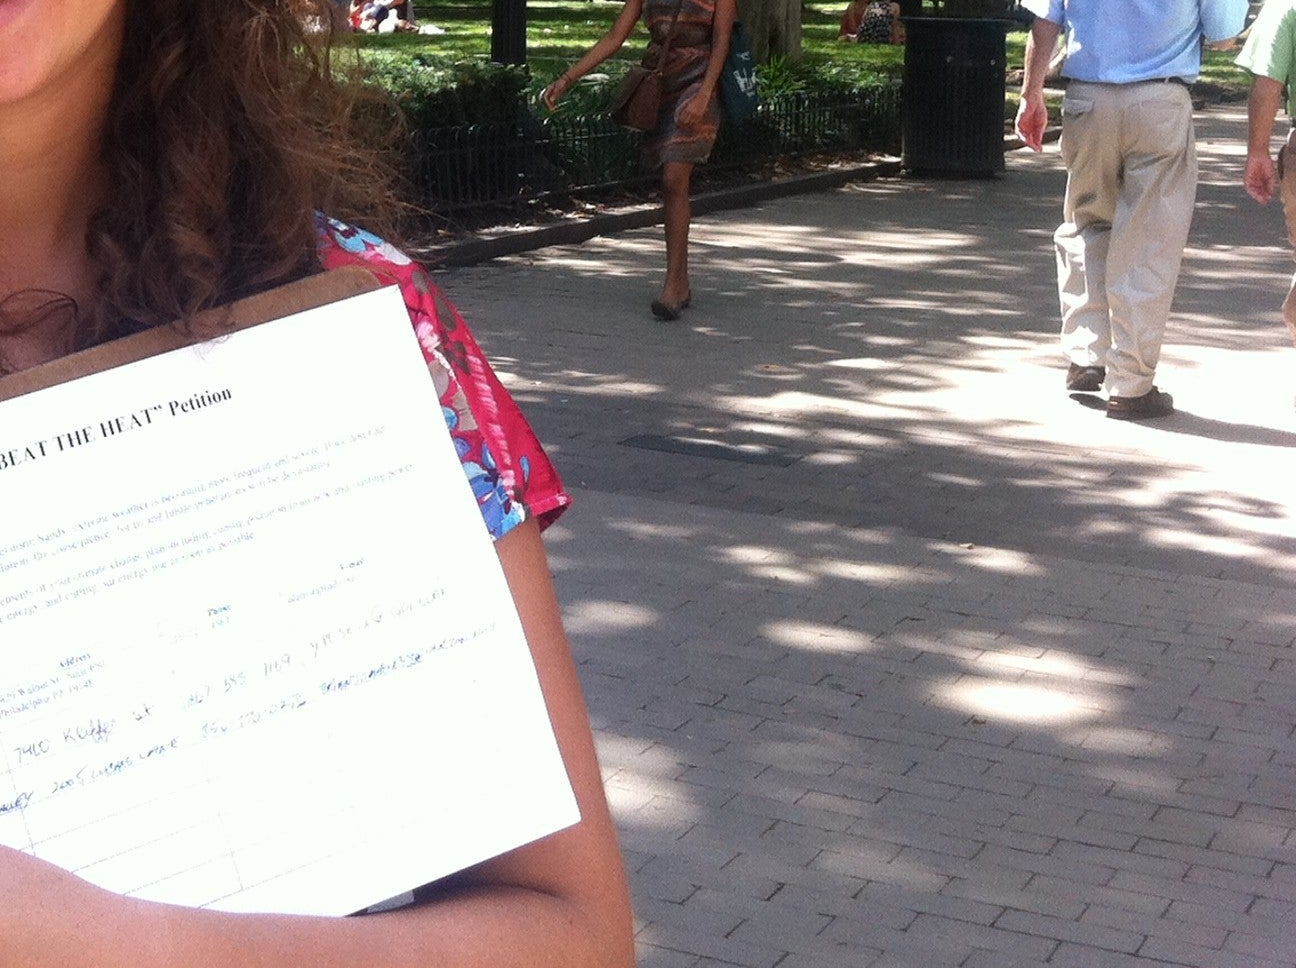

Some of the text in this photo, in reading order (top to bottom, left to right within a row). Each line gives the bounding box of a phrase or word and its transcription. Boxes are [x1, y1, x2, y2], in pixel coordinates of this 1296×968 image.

[55, 426, 92, 452] THE
[168, 388, 232, 417] Petition
[111, 501, 149, 519] weather
[233, 461, 272, 480] frequent
[273, 455, 290, 468] and
[32, 551, 48, 561] the
[146, 511, 163, 525] and
[164, 504, 191, 520] future
[109, 553, 143, 570] change
[145, 545, 166, 560] plan
[45, 593, 63, 608] and
[117, 567, 149, 583] energy
